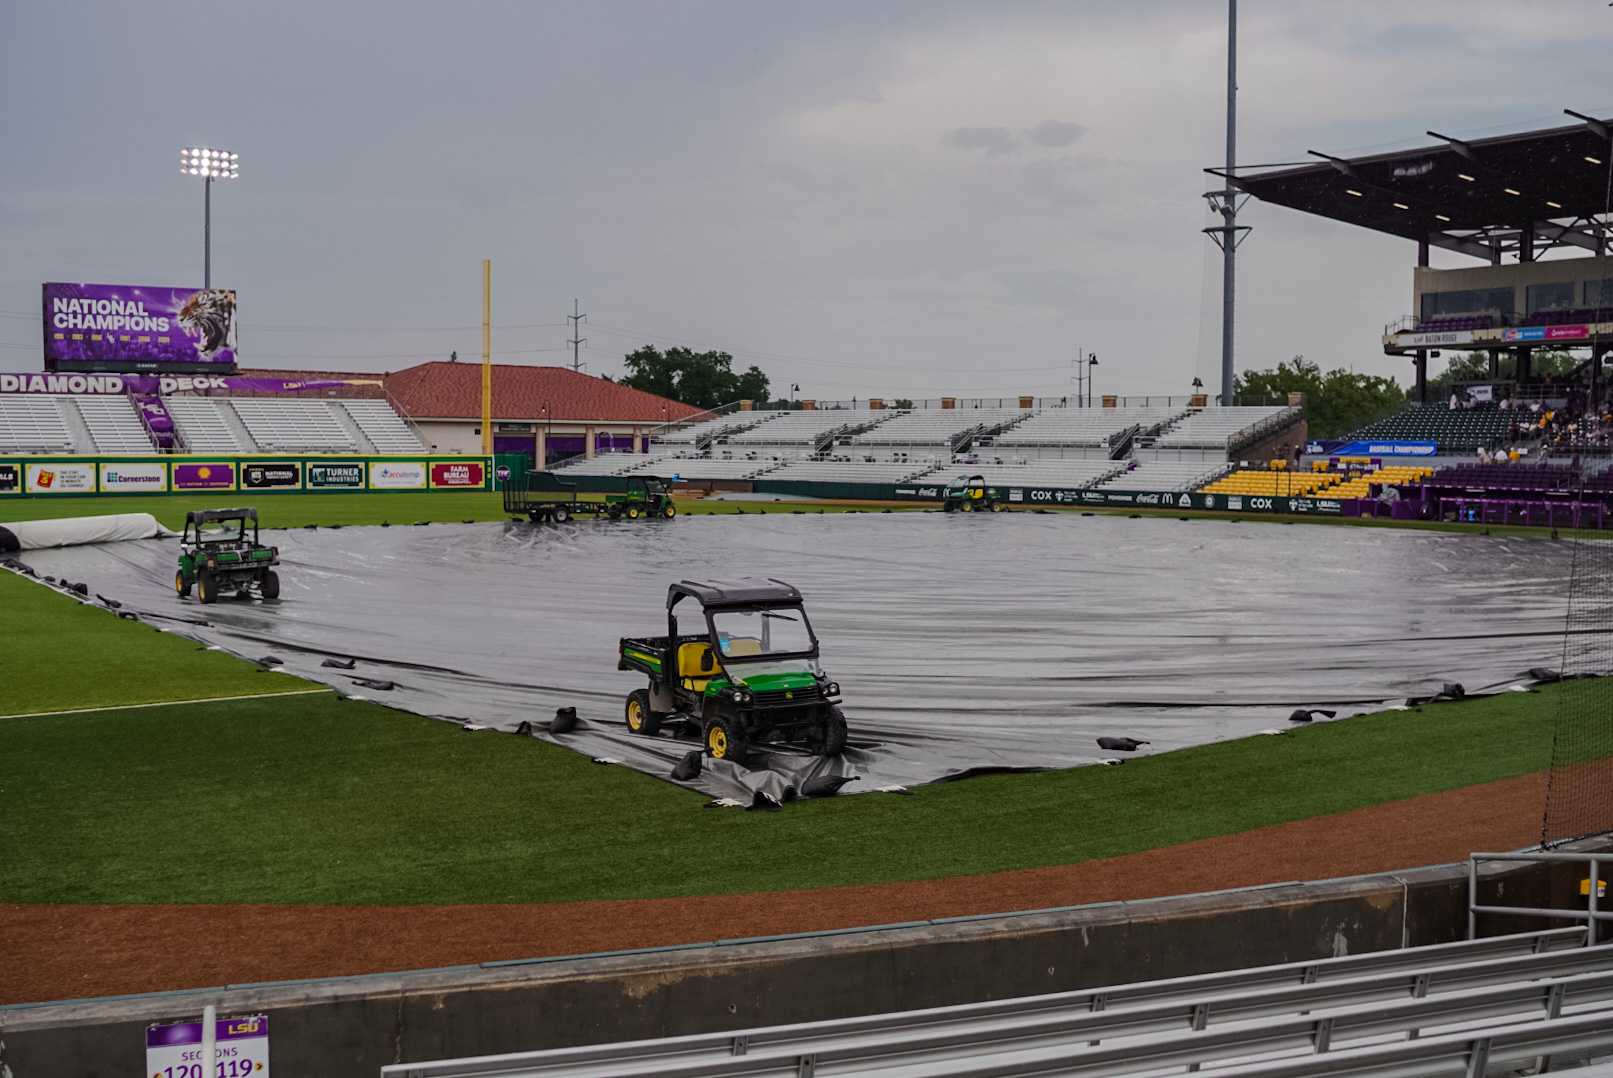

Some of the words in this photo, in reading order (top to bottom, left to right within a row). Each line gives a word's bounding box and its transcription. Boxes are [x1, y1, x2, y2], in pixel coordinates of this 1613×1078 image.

[54, 297, 149, 316] NATIONAL
[54, 313, 170, 332] CHAMPIONS
[1, 375, 123, 393] DIAMOND
[161, 376, 229, 394] DECK
[326, 467, 360, 476] TURNER
[1031, 490, 1052, 500] COX
[1250, 498, 1272, 509] COX
[228, 1023, 259, 1035] LSU
[182, 1047, 238, 1061] SECONS
[216, 1059, 253, 1078] 119
